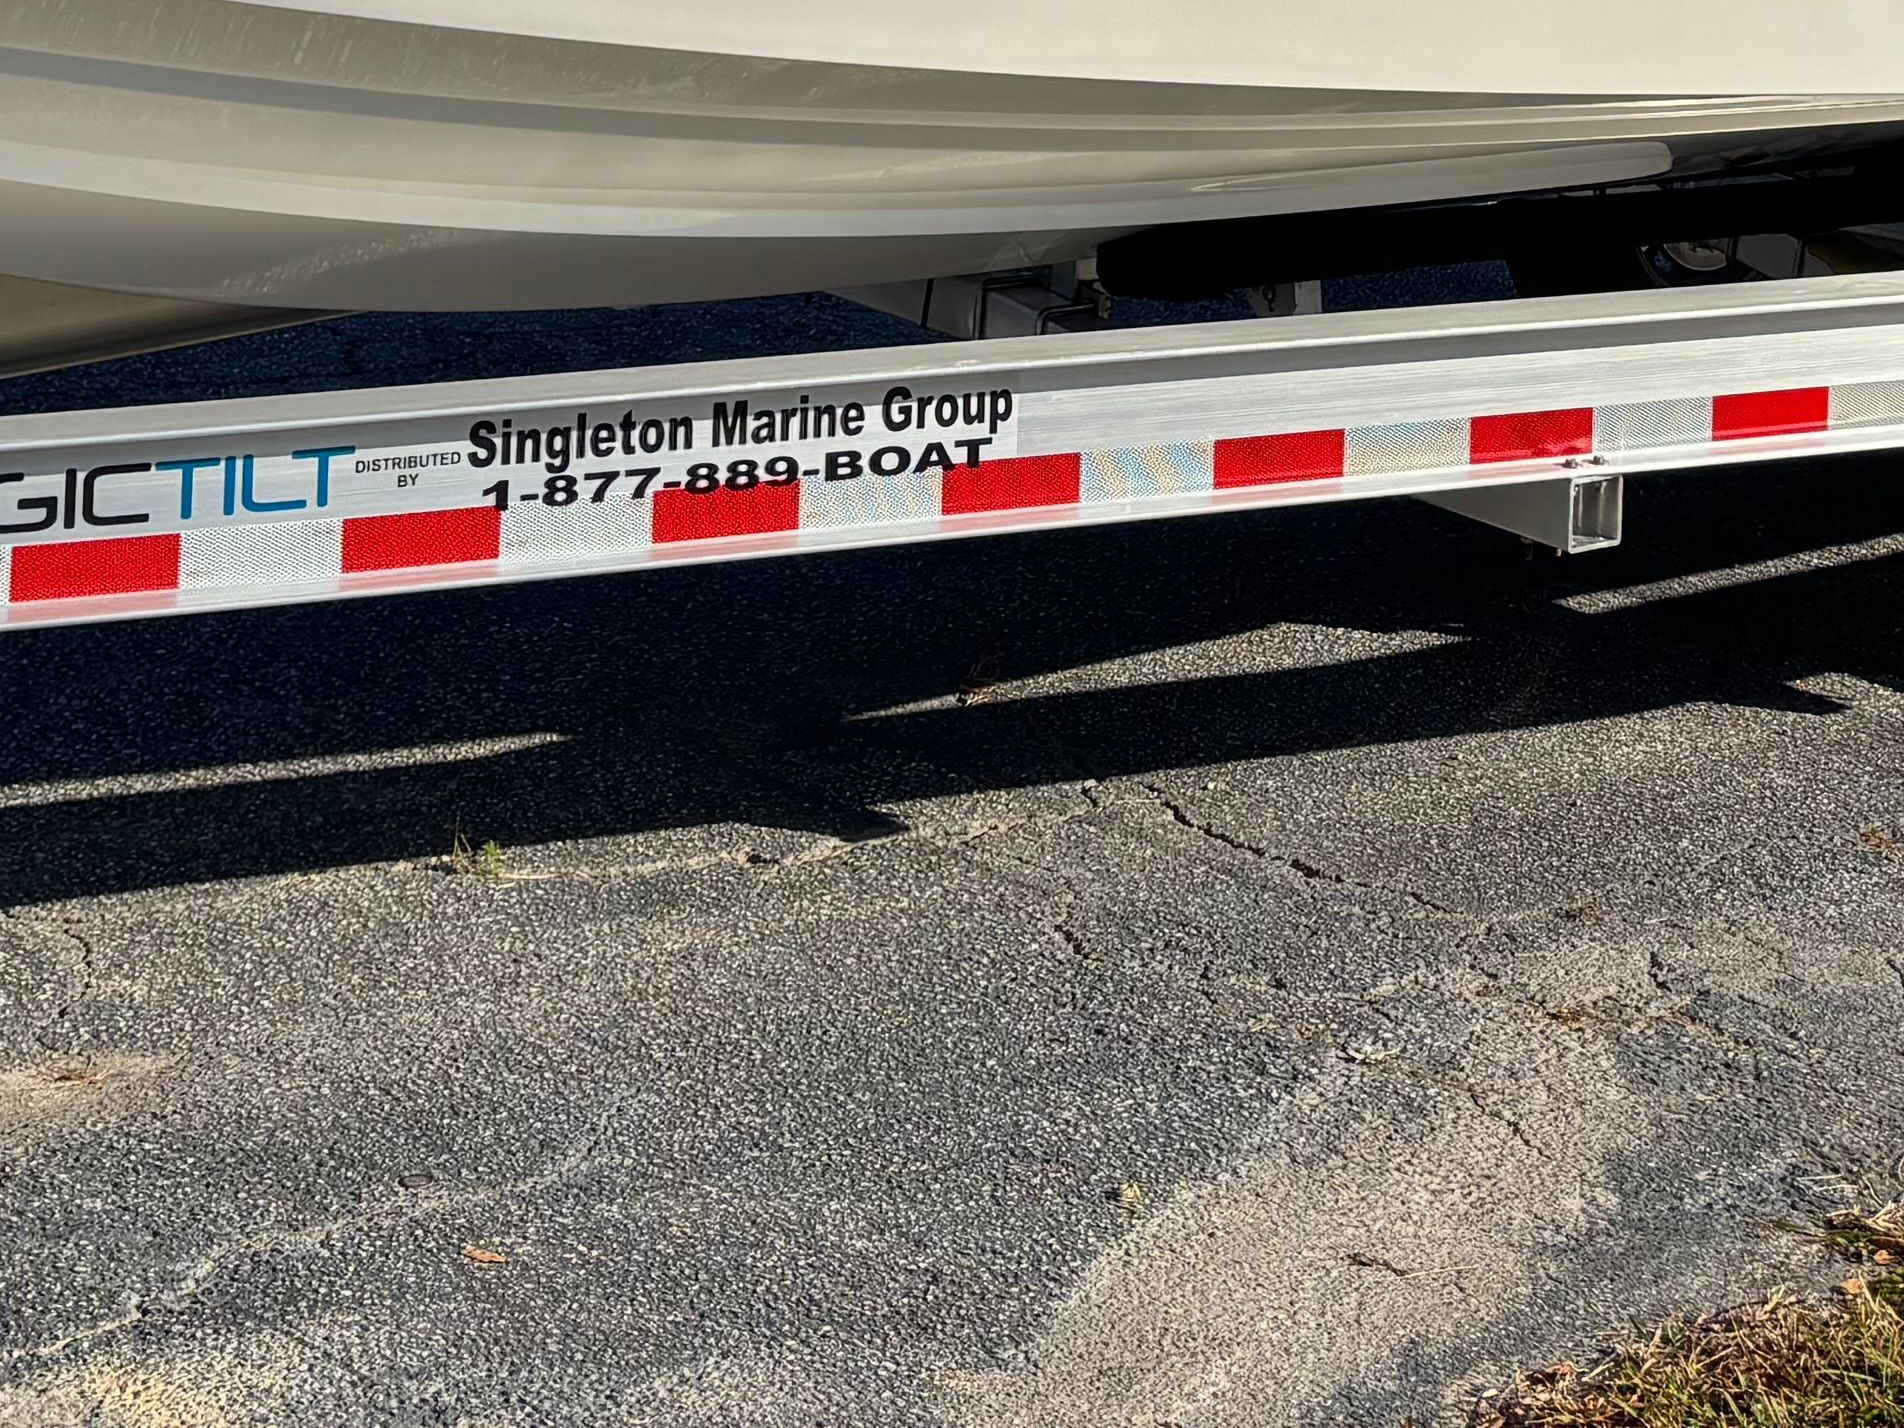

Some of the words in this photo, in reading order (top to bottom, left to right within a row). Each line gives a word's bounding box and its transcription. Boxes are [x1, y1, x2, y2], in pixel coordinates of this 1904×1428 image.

[467, 408, 693, 473] Singleton
[711, 395, 865, 448] Marine
[881, 386, 1013, 434] Group
[355, 451, 461, 474] DISTRIBUTED
[397, 473, 419, 488] BY
[481, 437, 993, 512] 1-877-889-BOAT
